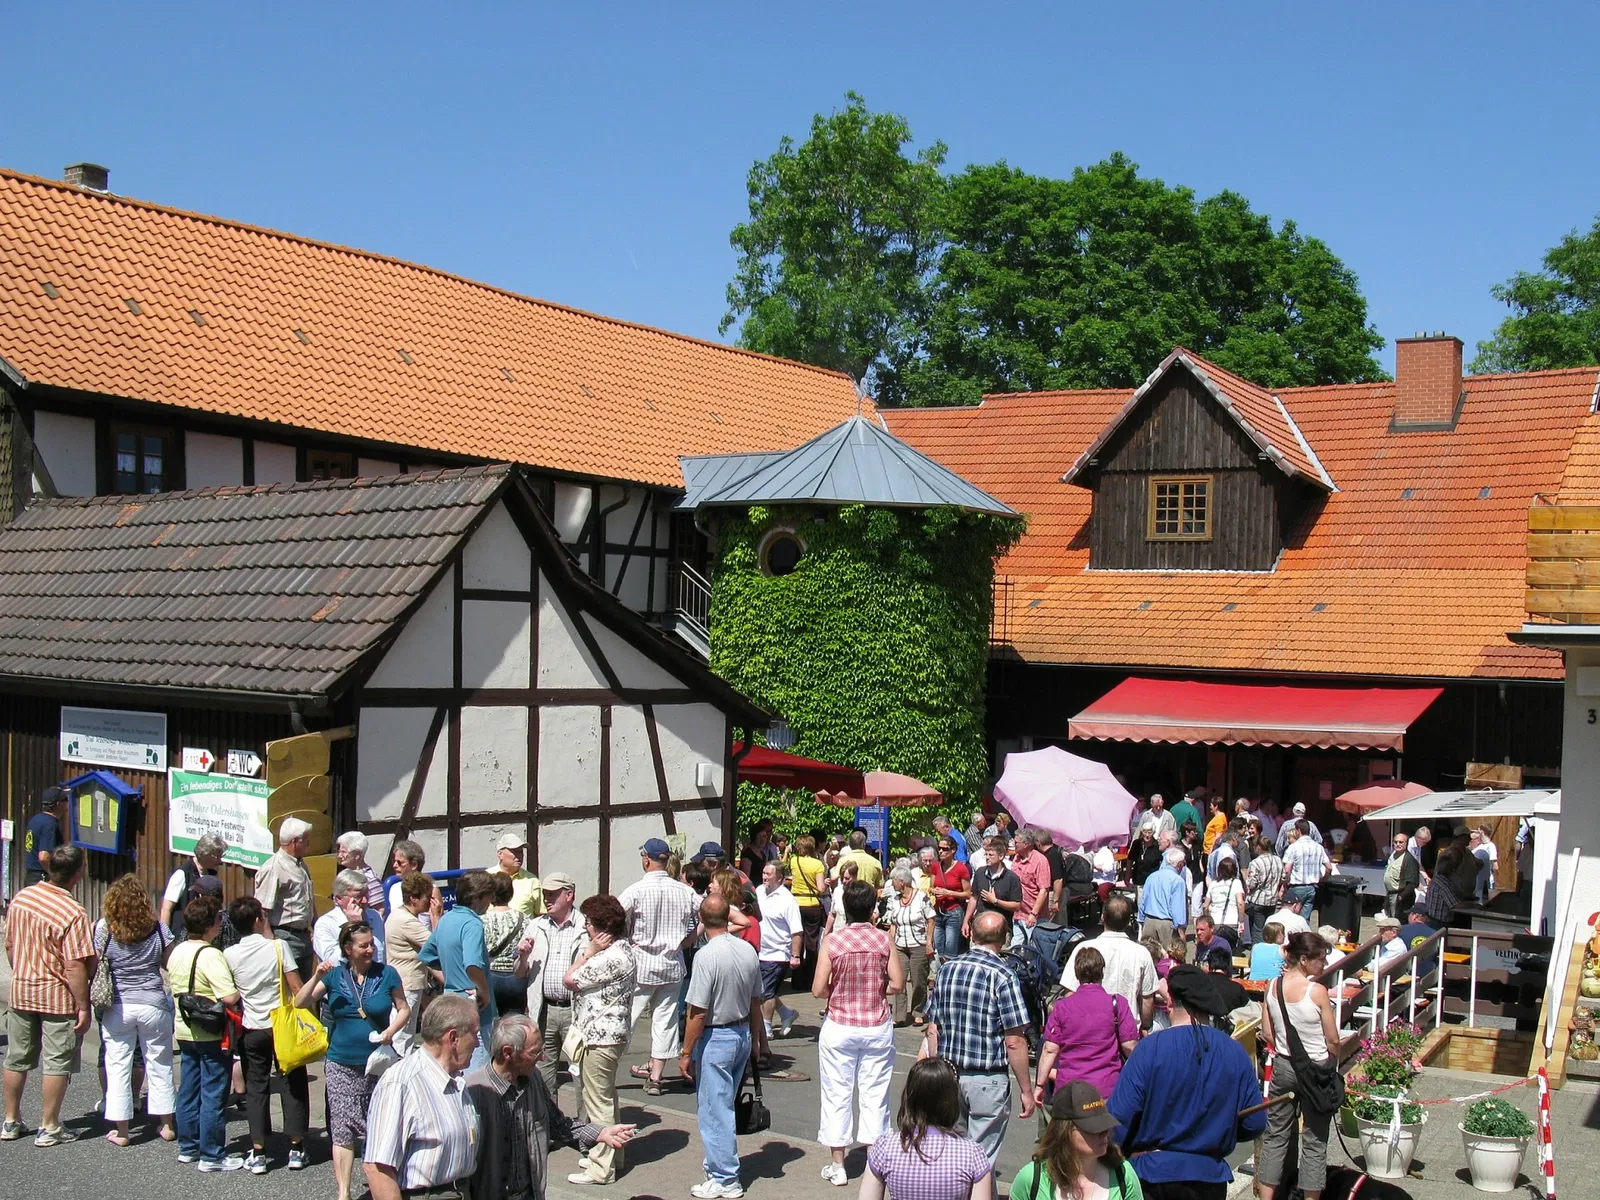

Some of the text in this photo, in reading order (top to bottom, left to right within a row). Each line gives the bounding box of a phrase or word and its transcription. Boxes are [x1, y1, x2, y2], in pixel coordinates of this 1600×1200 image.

[1587, 709, 1597, 724] 3
[239, 753, 253, 774] WC
[180, 783, 189, 792] Ein
[190, 780, 222, 792] lebendiges
[224, 780, 236, 790] Dorf
[237, 782, 253, 793] stellt
[254, 785, 268, 795] sich
[192, 801, 209, 814] Jahre
[184, 813, 210, 828] Einladung
[210, 819, 220, 828] zur
[186, 826, 196, 834] vom
[224, 830, 234, 841] Mai
